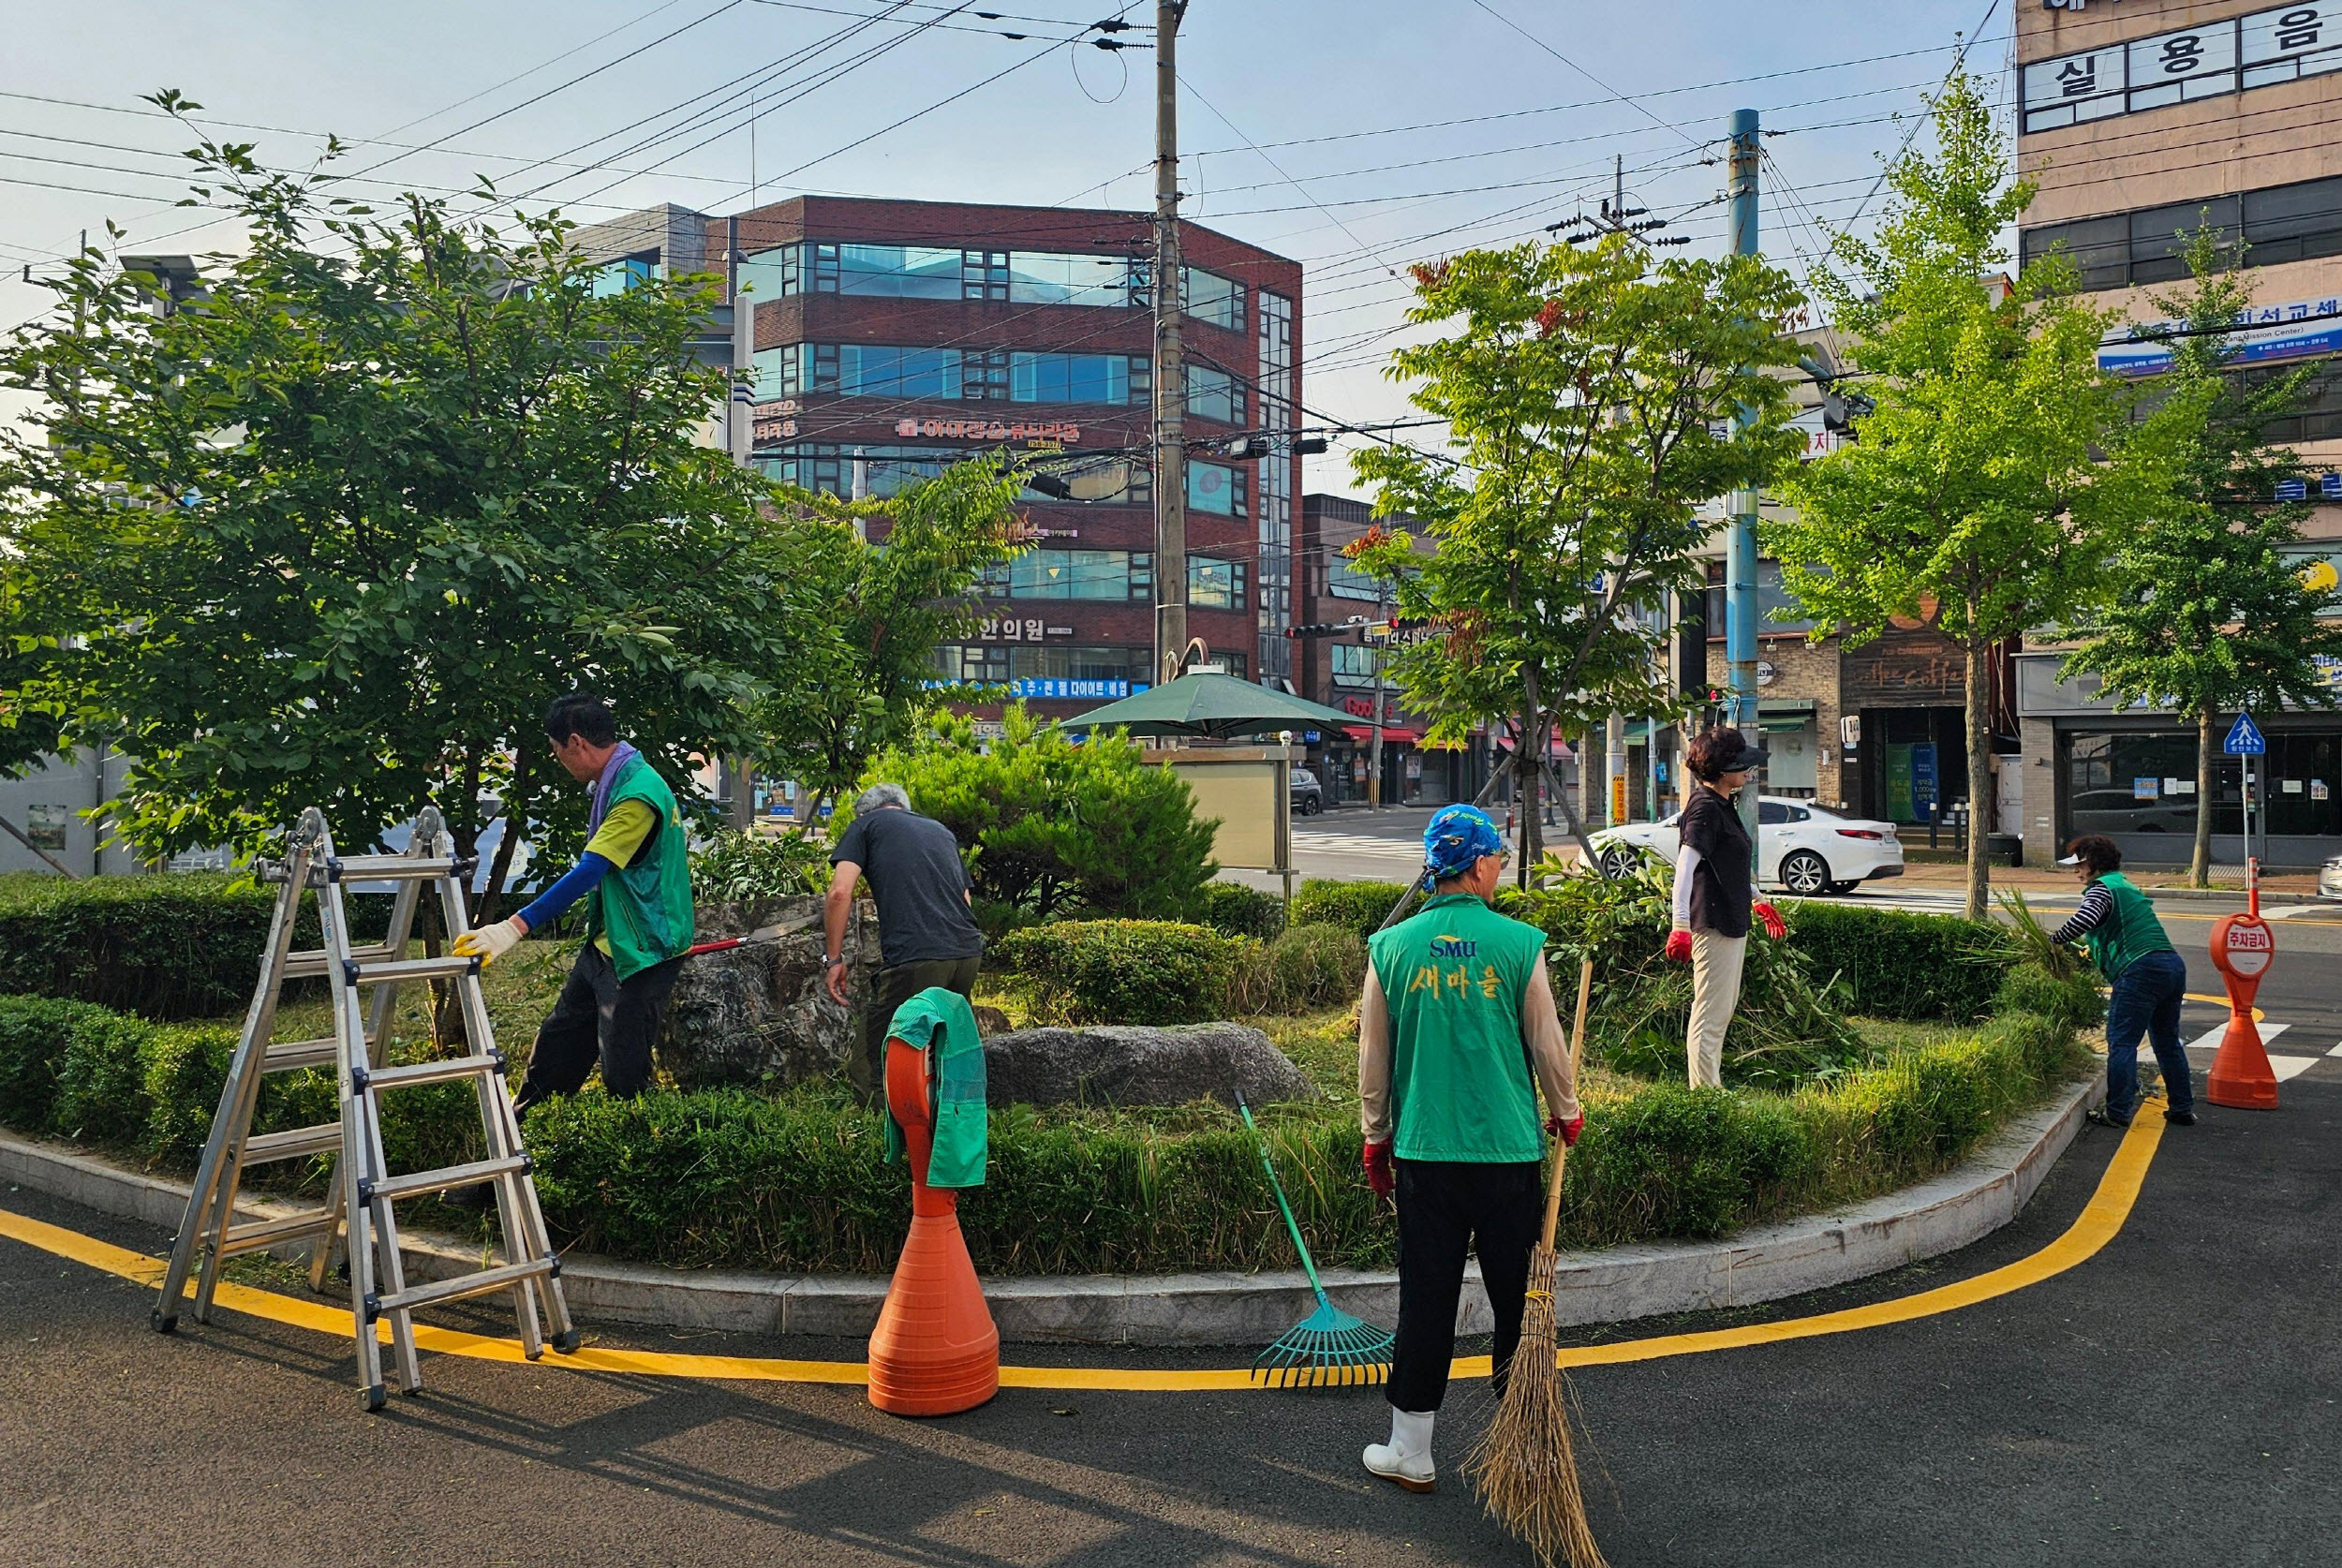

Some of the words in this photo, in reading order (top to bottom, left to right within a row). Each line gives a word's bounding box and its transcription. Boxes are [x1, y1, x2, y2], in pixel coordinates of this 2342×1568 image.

[2275, 327, 2304, 337] Center)
[1011, 422, 1079, 442] 뷰티라인
[1430, 939, 1476, 957] SMU
[2230, 932, 2266, 948] 주차금지
[1410, 964, 1502, 1000] 새마을
